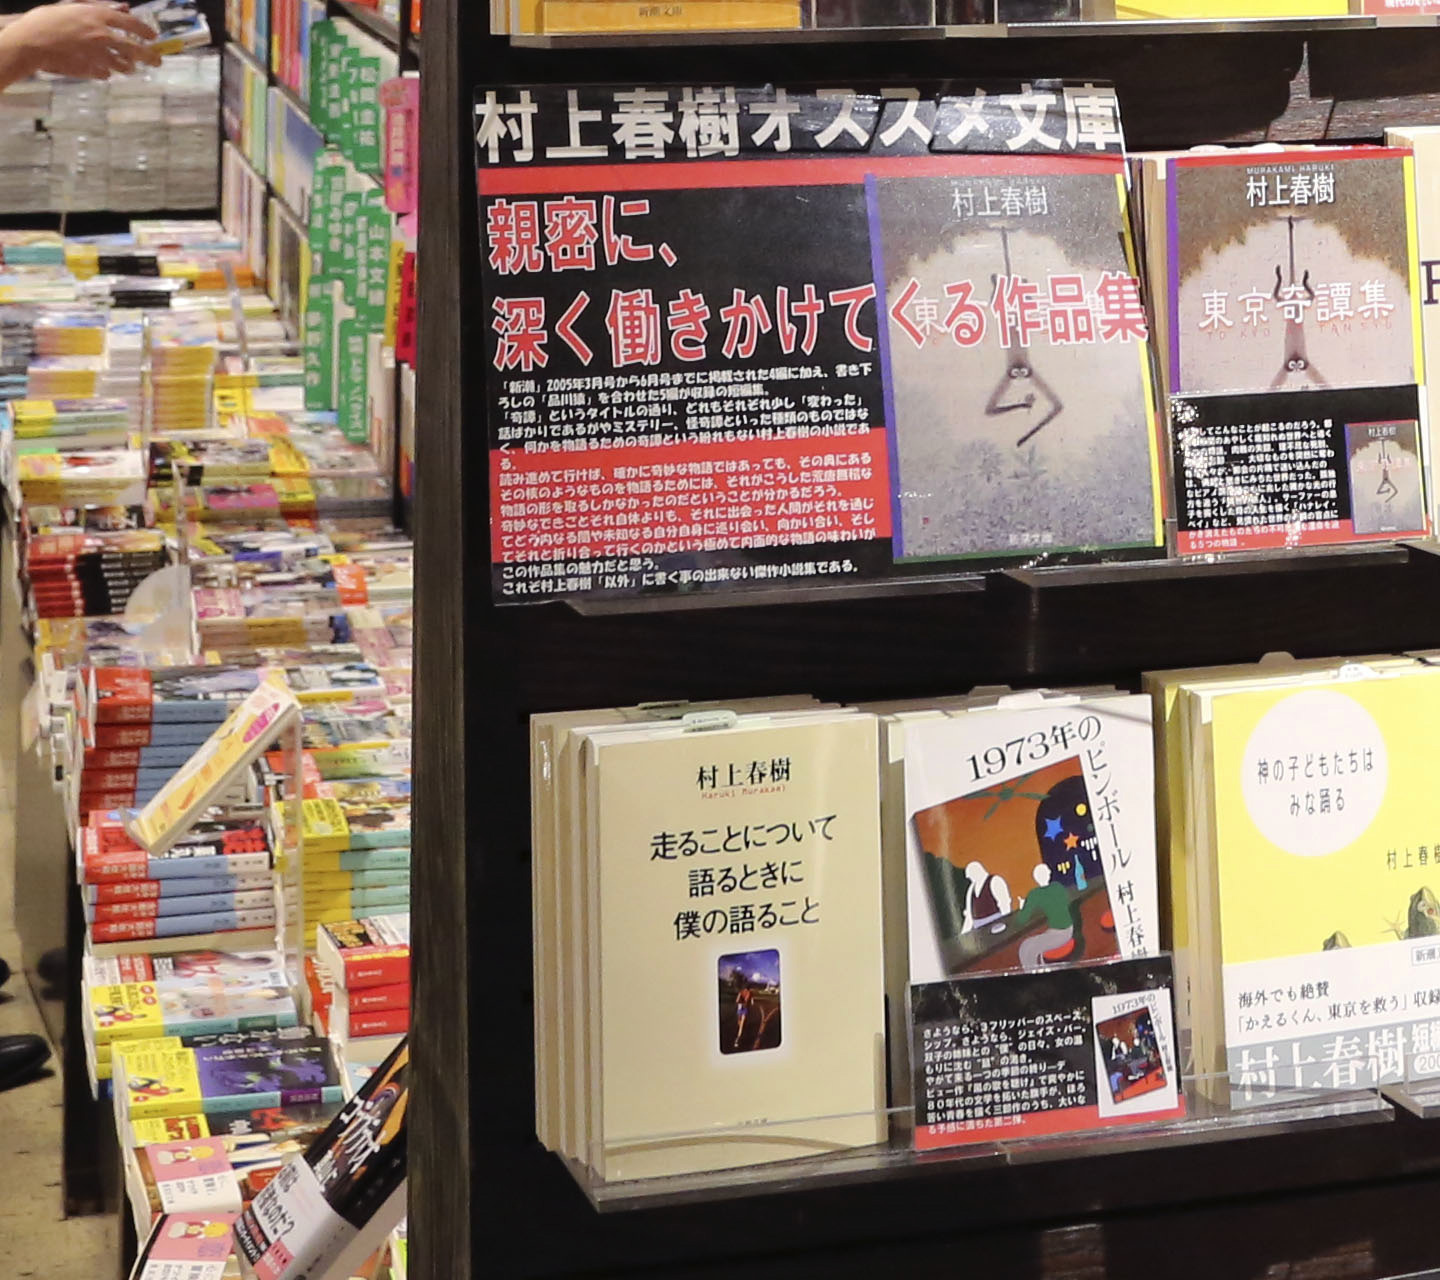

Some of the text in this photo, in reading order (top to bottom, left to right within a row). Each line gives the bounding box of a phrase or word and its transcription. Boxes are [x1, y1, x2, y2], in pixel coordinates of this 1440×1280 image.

[475, 84, 1124, 164] 村上春樹オススメ文庫
[1246, 172, 1336, 208] 村上春樹
[488, 194, 678, 275] 親密に、
[491, 271, 1150, 372] 深く働きかけてくる作品集
[1198, 280, 1395, 330] 東京奇譚集
[965, 714, 1102, 783] 1973年の
[1256, 747, 1374, 785] 神の子どもたちは
[696, 756, 792, 791] 村上春樹
[1084, 740, 1133, 872] ピンボール
[1289, 787, 1346, 818] みな踊る
[649, 814, 838, 862] 走ることについて
[687, 857, 804, 898] 語るときに
[672, 895, 821, 941] 僕の語ること
[1237, 980, 1331, 1009] 海外でも絶賛
[1233, 1025, 1408, 1104] 村上春樹
